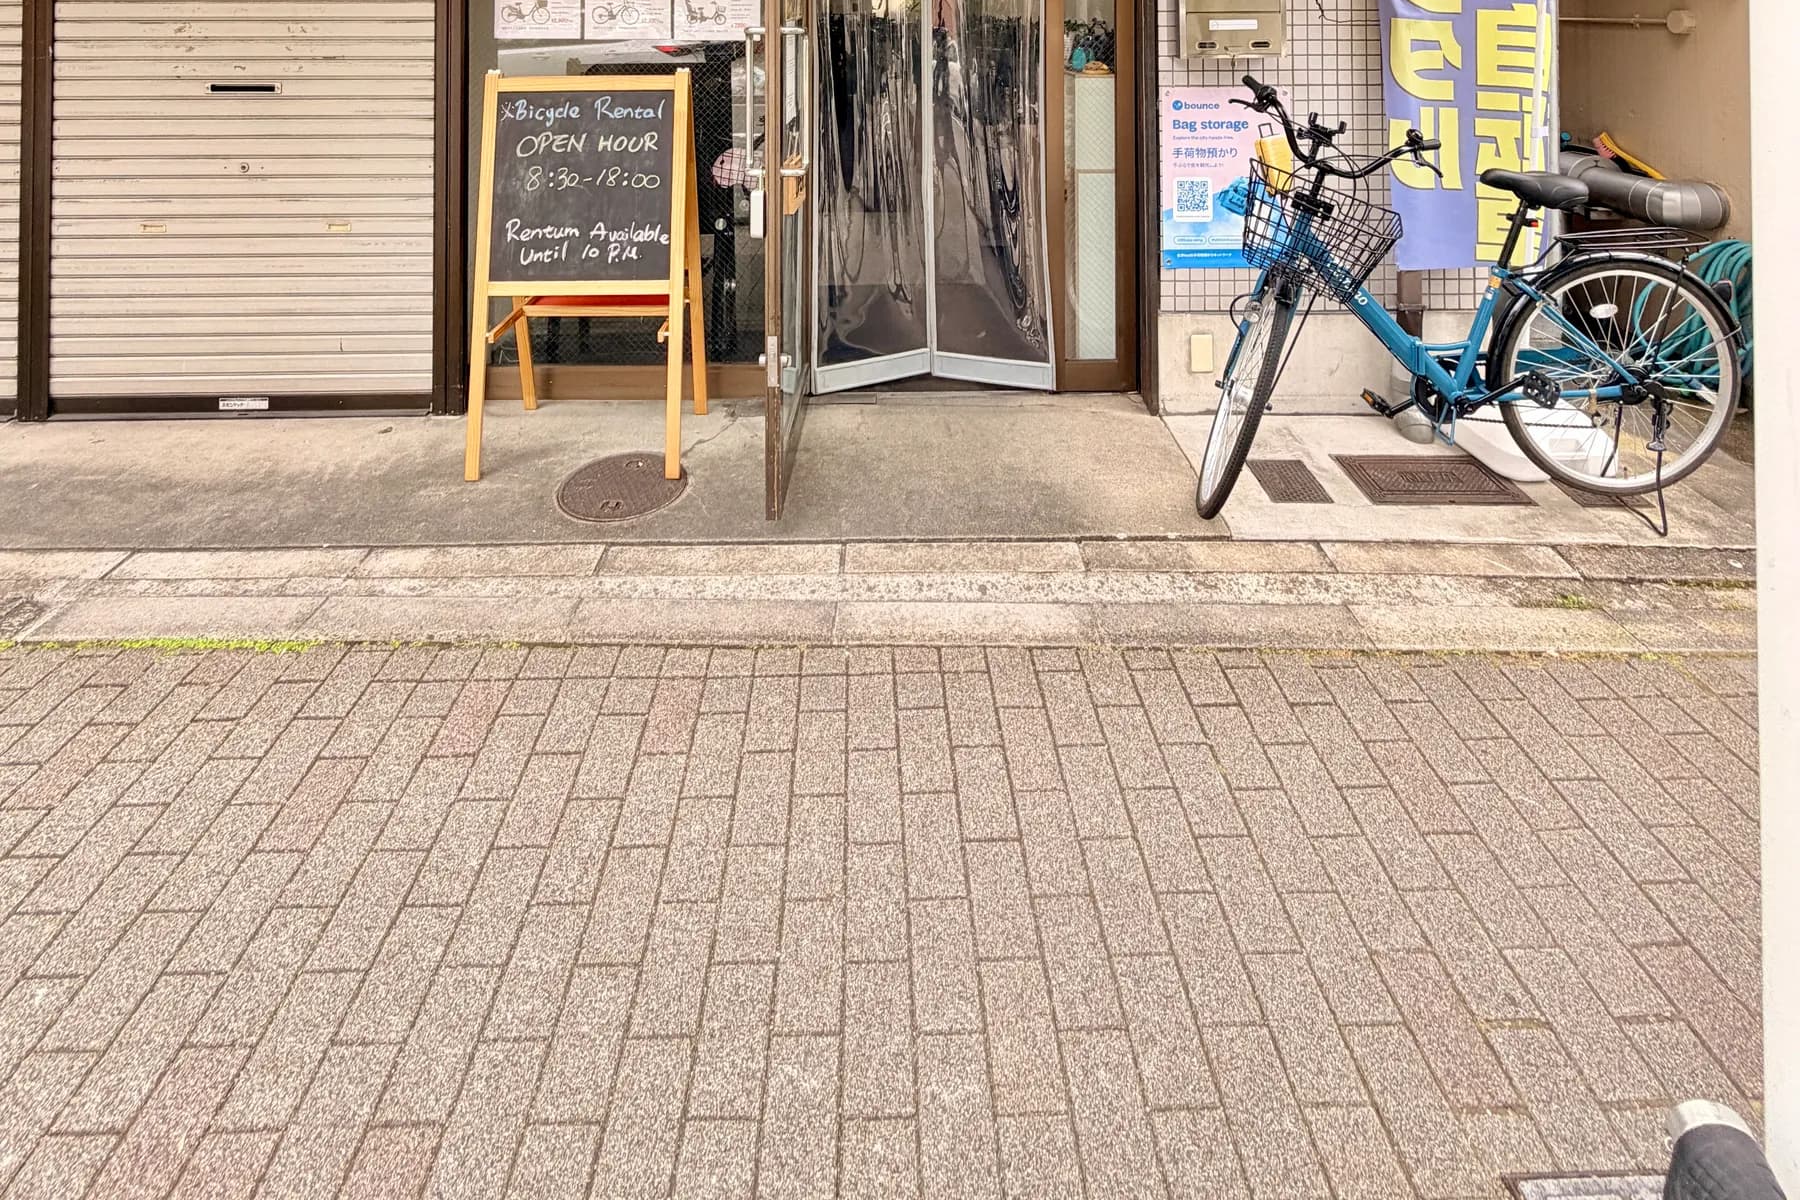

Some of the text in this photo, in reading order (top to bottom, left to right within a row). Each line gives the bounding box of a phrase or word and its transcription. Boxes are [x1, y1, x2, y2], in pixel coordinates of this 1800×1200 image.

[594, 96, 666, 120] Rental
[1184, 101, 1220, 110] bounce
[1172, 119, 1249, 132] Bag storage
[516, 131, 659, 157] OPEN HOUR
[1172, 147, 1238, 159] 手荷物預かり
[590, 221, 670, 245] Available
[520, 242, 568, 265] Until
[581, 244, 599, 259] 10
